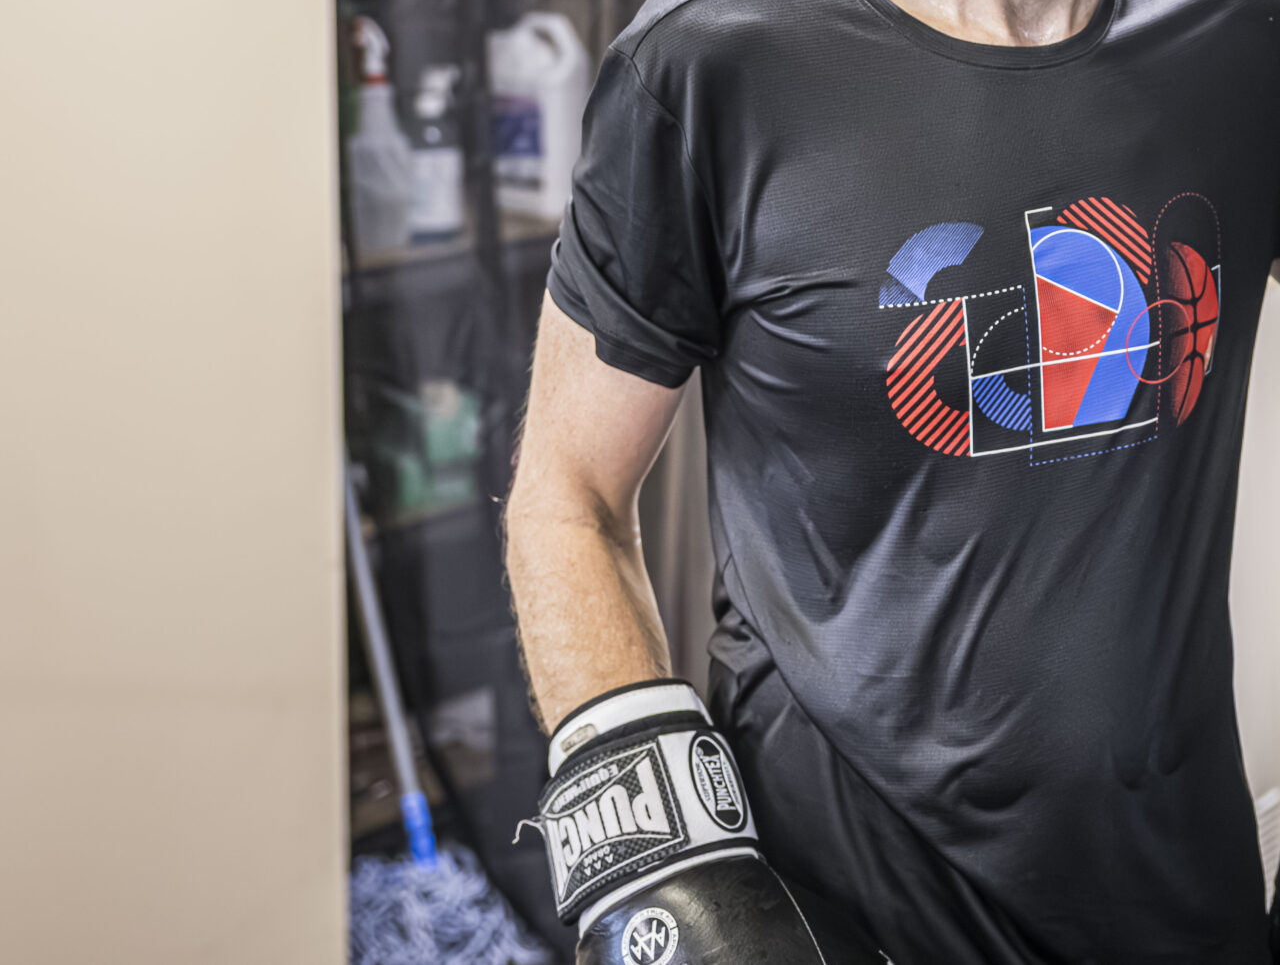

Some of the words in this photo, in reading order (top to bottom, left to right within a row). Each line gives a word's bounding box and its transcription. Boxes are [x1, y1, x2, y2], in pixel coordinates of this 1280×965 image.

[551, 763, 619, 813] EQUIPMENT
[701, 752, 737, 812] PUNCHTEX
[547, 755, 672, 897] PUNCH
